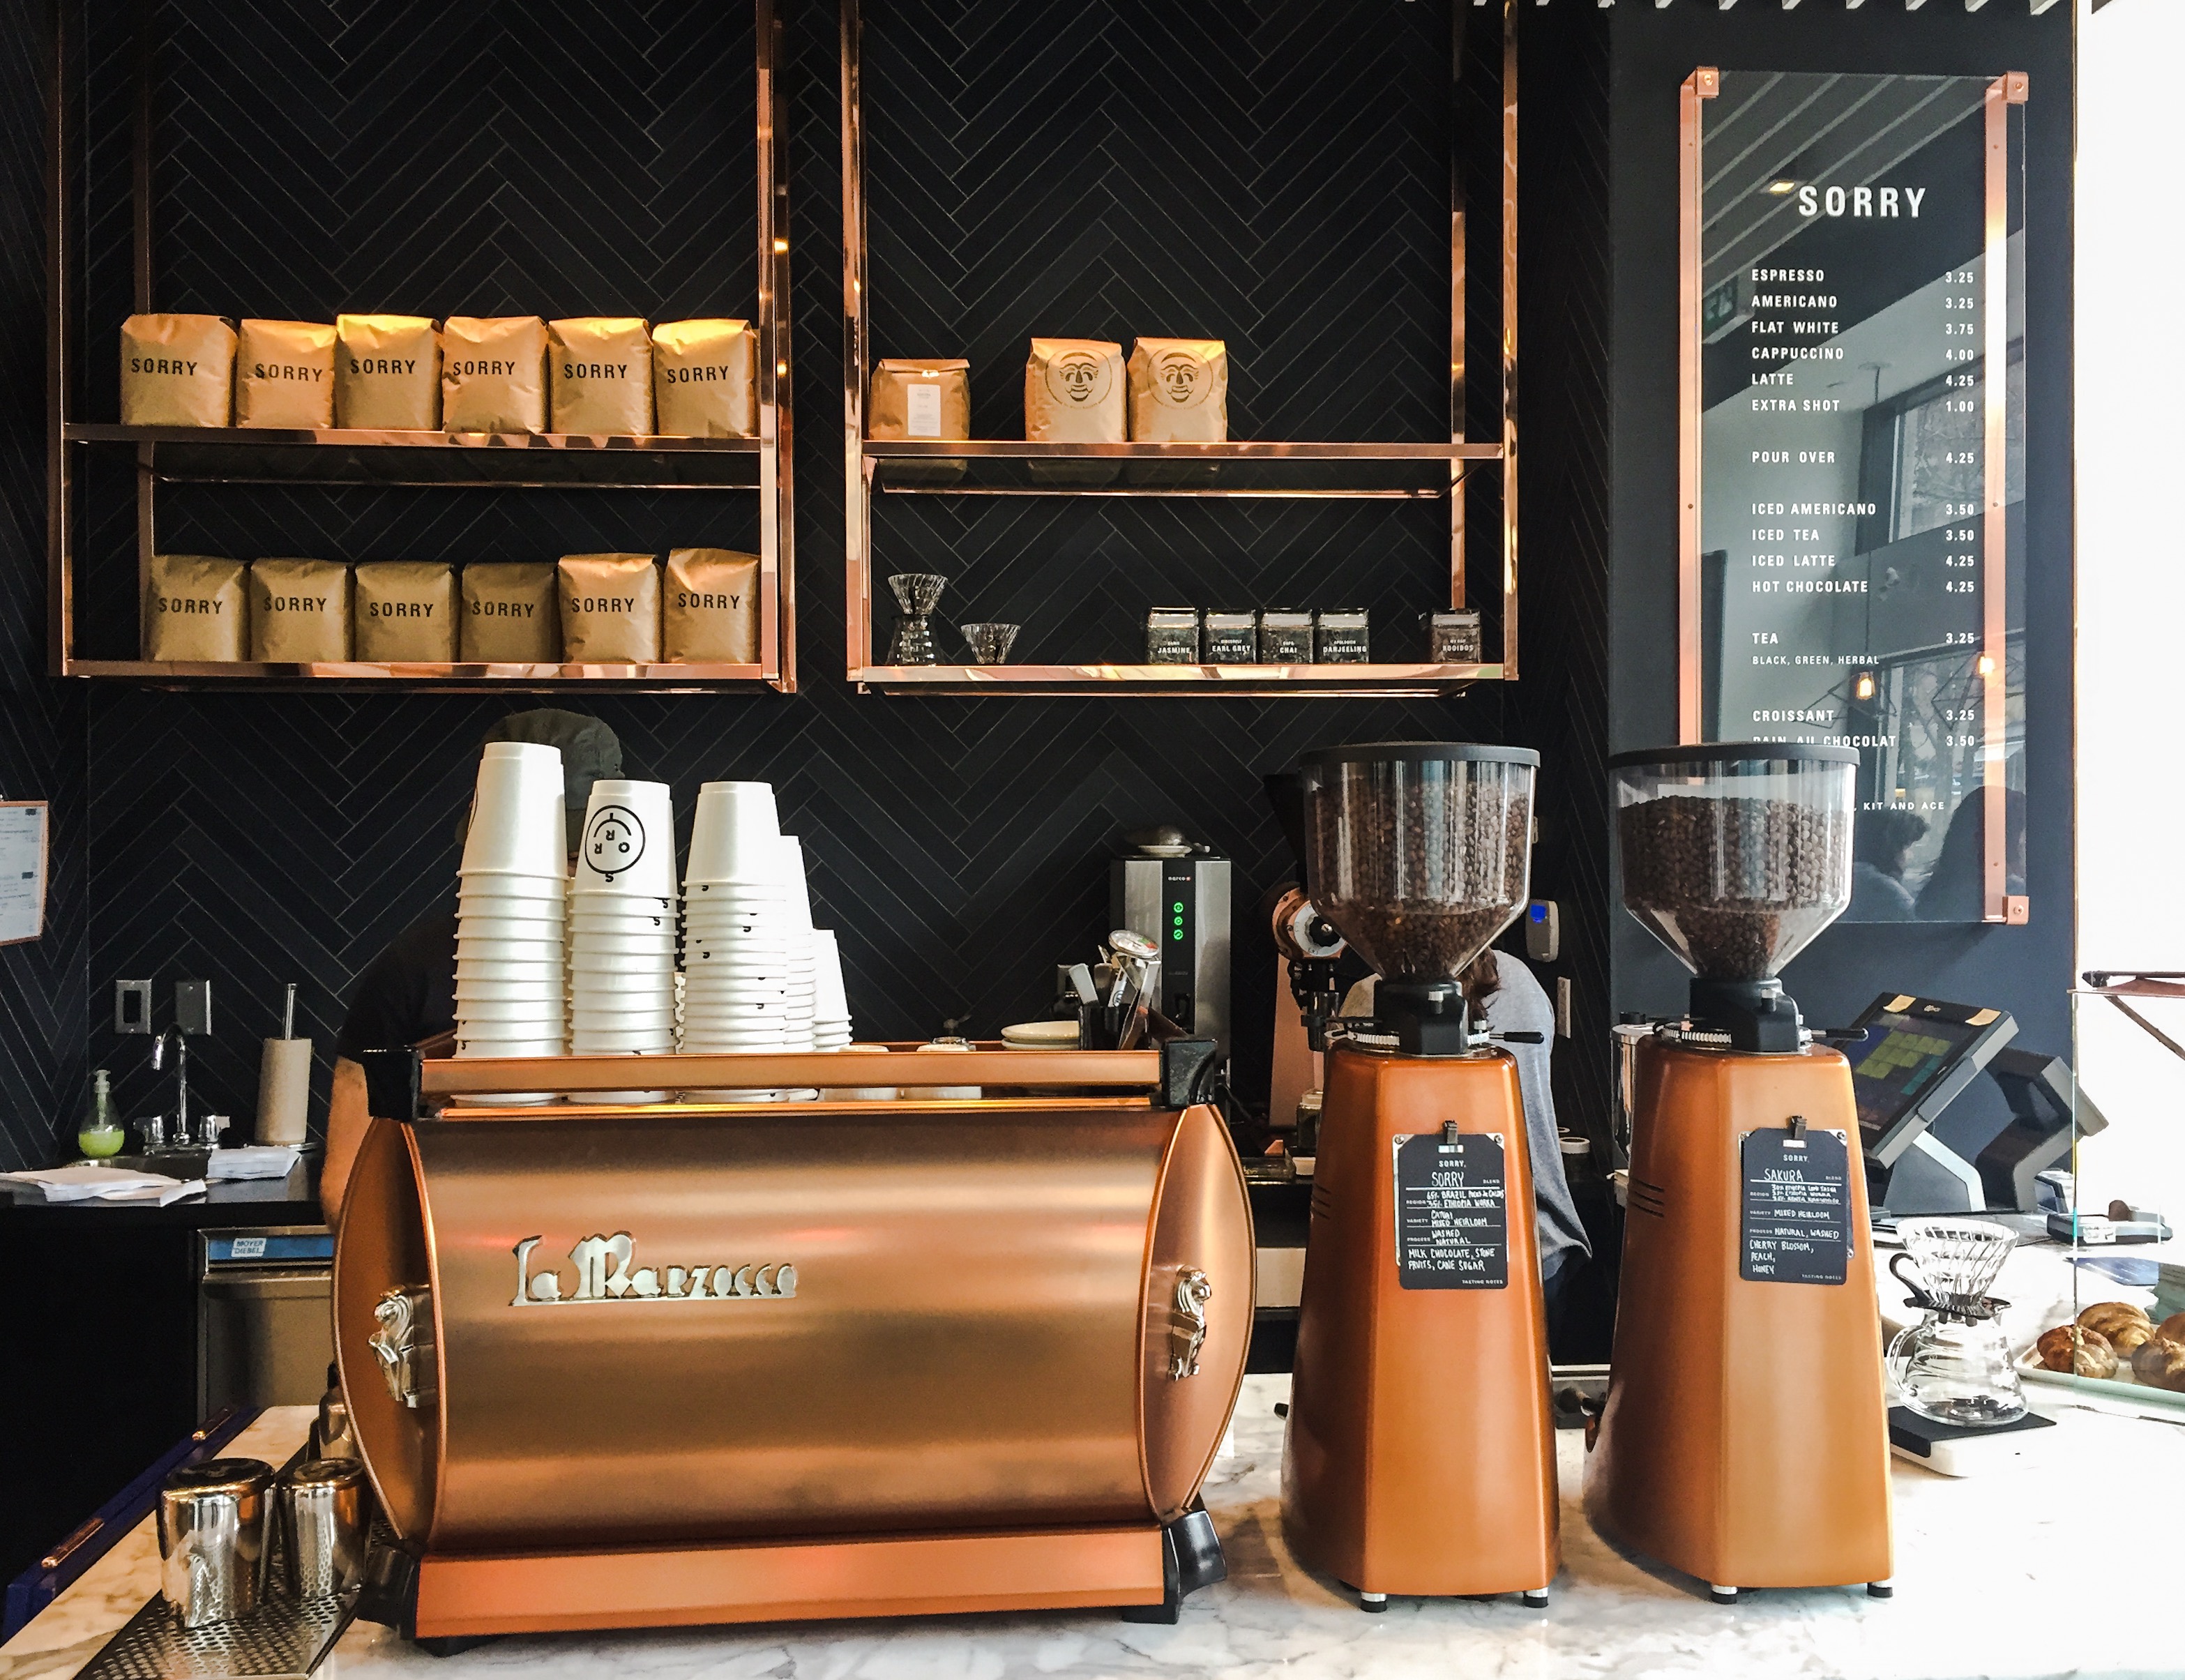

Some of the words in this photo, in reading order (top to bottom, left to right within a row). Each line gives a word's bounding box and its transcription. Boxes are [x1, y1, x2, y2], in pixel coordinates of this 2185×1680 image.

[1799, 186, 1926, 218] SORRY
[1752, 269, 1824, 281] ESPRESSO
[1946, 272, 1973, 283] 3.25
[1752, 295, 1836, 308] AMERICANO
[1946, 298, 1973, 309] 3.25
[1752, 321, 1784, 333] FLAT
[1793, 321, 1838, 333] WHITE
[1946, 324, 1973, 334] 3.75
[1752, 347, 1843, 359] CAPPUCCINO
[1946, 349, 1973, 361] 4.00
[132, 358, 197, 375] SORRY
[255, 363, 322, 381] SORRY
[351, 359, 415, 374] SORRY
[453, 361, 515, 375] SORRY
[565, 364, 627, 379] SORRY
[668, 366, 728, 383] SORRY
[1752, 373, 1792, 384] LATTE
[1946, 375, 1974, 386] 4.25
[1753, 400, 1796, 411] EXTRA
[1804, 400, 1839, 411] SHOT
[1946, 401, 1974, 411] 1.00
[1753, 451, 1789, 462] POUR
[1799, 452, 1834, 463] OVER
[1946, 453, 1974, 463] 4.25
[1753, 504, 1783, 514] ICED
[1791, 504, 1875, 515] AMERICANO
[1946, 504, 1974, 515] 3.50
[1753, 529, 1783, 540] ICED
[1794, 529, 1819, 540] TEA
[1946, 530, 1974, 540] 3.50
[1753, 555, 1783, 566] ICED
[1794, 555, 1835, 566] LATTE
[1946, 556, 1974, 566] 4.25
[1753, 581, 1779, 592] HOT
[1787, 581, 1868, 592] CHOCOLATE
[1946, 582, 1974, 592] 4.25
[160, 598, 222, 614] SORRY
[264, 596, 328, 612] SORRY
[573, 598, 634, 612] SORRY
[679, 593, 739, 609] SORRY
[370, 603, 433, 617] SORRY
[472, 600, 534, 617] SORRY
[1753, 633, 1778, 644] TEA
[1946, 633, 1974, 644] 3.25
[1752, 656, 1790, 666] BLACK,
[1795, 656, 1834, 666] GREEN,
[1838, 656, 1880, 665] HERBAL
[1753, 710, 1834, 722] CROISSANT
[1945, 709, 1974, 721] 3.25
[1823, 736, 1896, 747] CHOCOLAT
[1947, 736, 1974, 746] 3.50
[1863, 802, 1884, 810] KIT
[1890, 801, 1915, 810] AND
[1921, 801, 1945, 810] ACE
[1432, 1172, 1464, 1187] SORRY
[1764, 1168, 1804, 1182] SAKURA
[1774, 1209, 1796, 1218] MIXED
[1798, 1211, 1830, 1219] HEIRLOOM
[1432, 1229, 1460, 1239] WASHED
[1810, 1230, 1839, 1239] WASHED
[1436, 1237, 1471, 1246] NATURAL
[1750, 1239, 1776, 1250] CHERRY
[1409, 1249, 1427, 1259] MILK
[1437, 1259, 1456, 1270] CANE
[1458, 1259, 1485, 1271] SUGAR
[1753, 1264, 1775, 1275] HONEY
